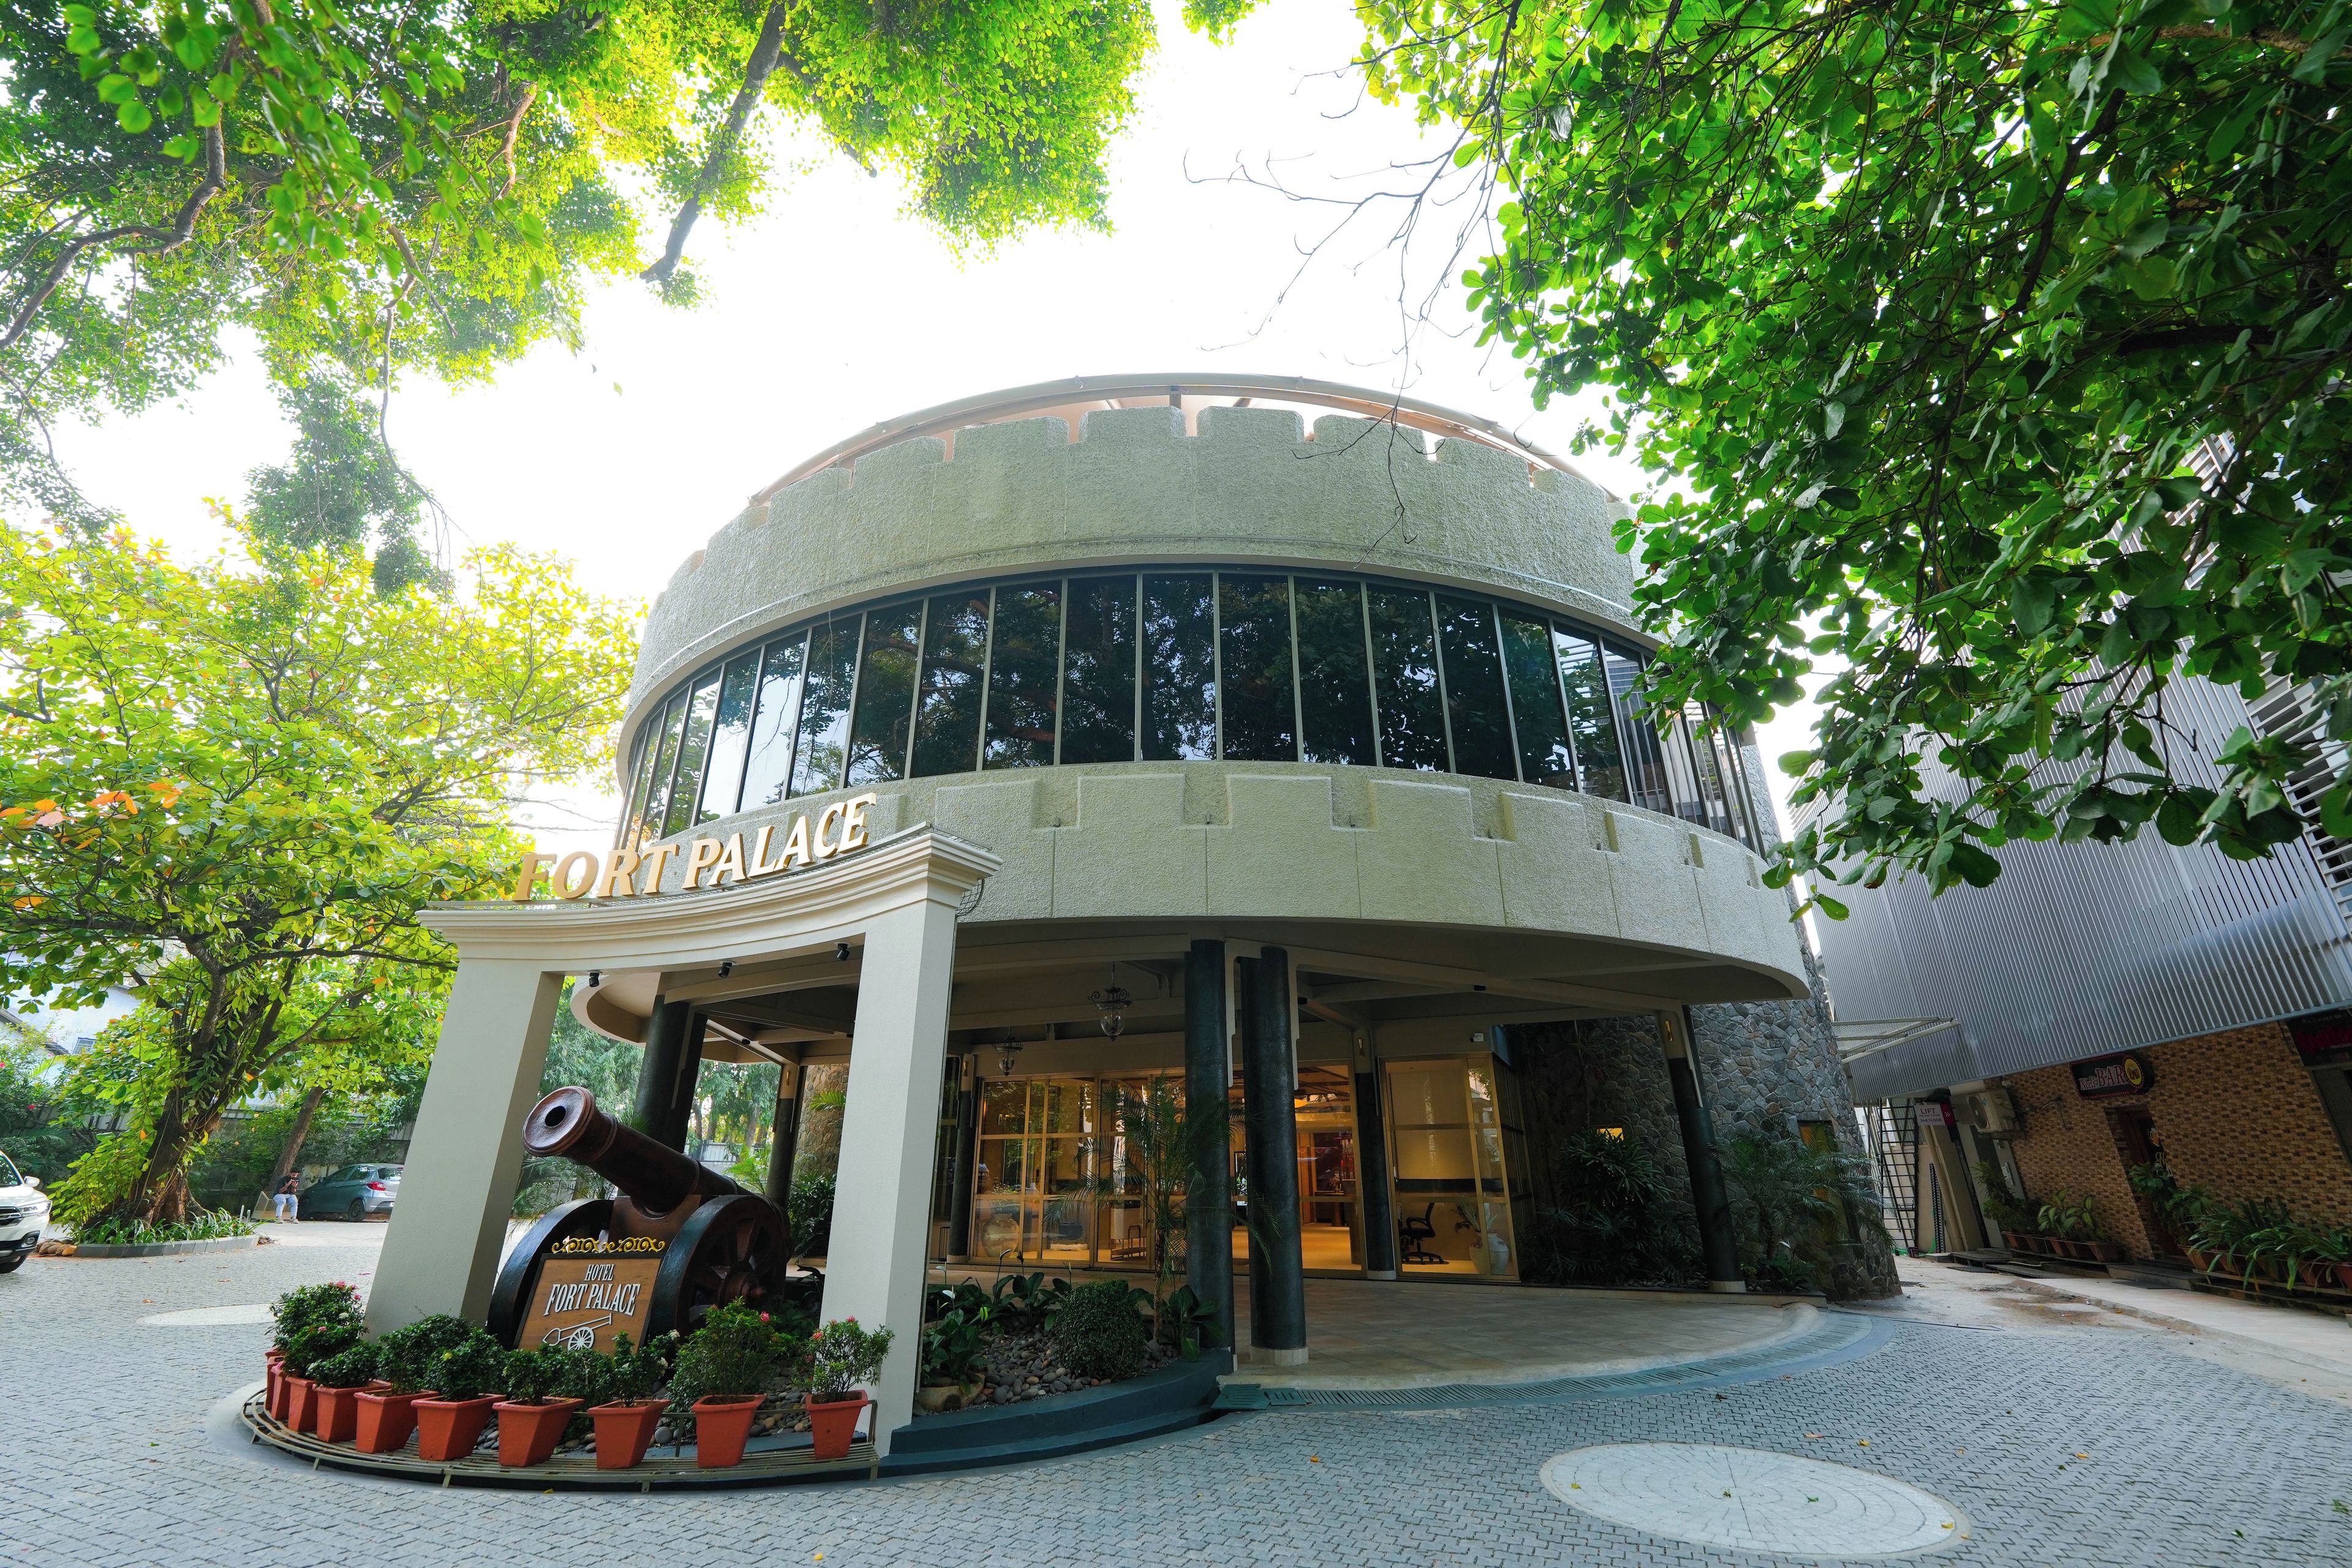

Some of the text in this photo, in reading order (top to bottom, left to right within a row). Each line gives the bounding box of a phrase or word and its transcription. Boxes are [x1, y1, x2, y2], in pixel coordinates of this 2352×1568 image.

[512, 793, 877, 902] FORT PALACE
[2095, 1065, 2125, 1087] BAR
[584, 1264, 616, 1281] HOTEL
[543, 1283, 641, 1317] FORT PALACE
